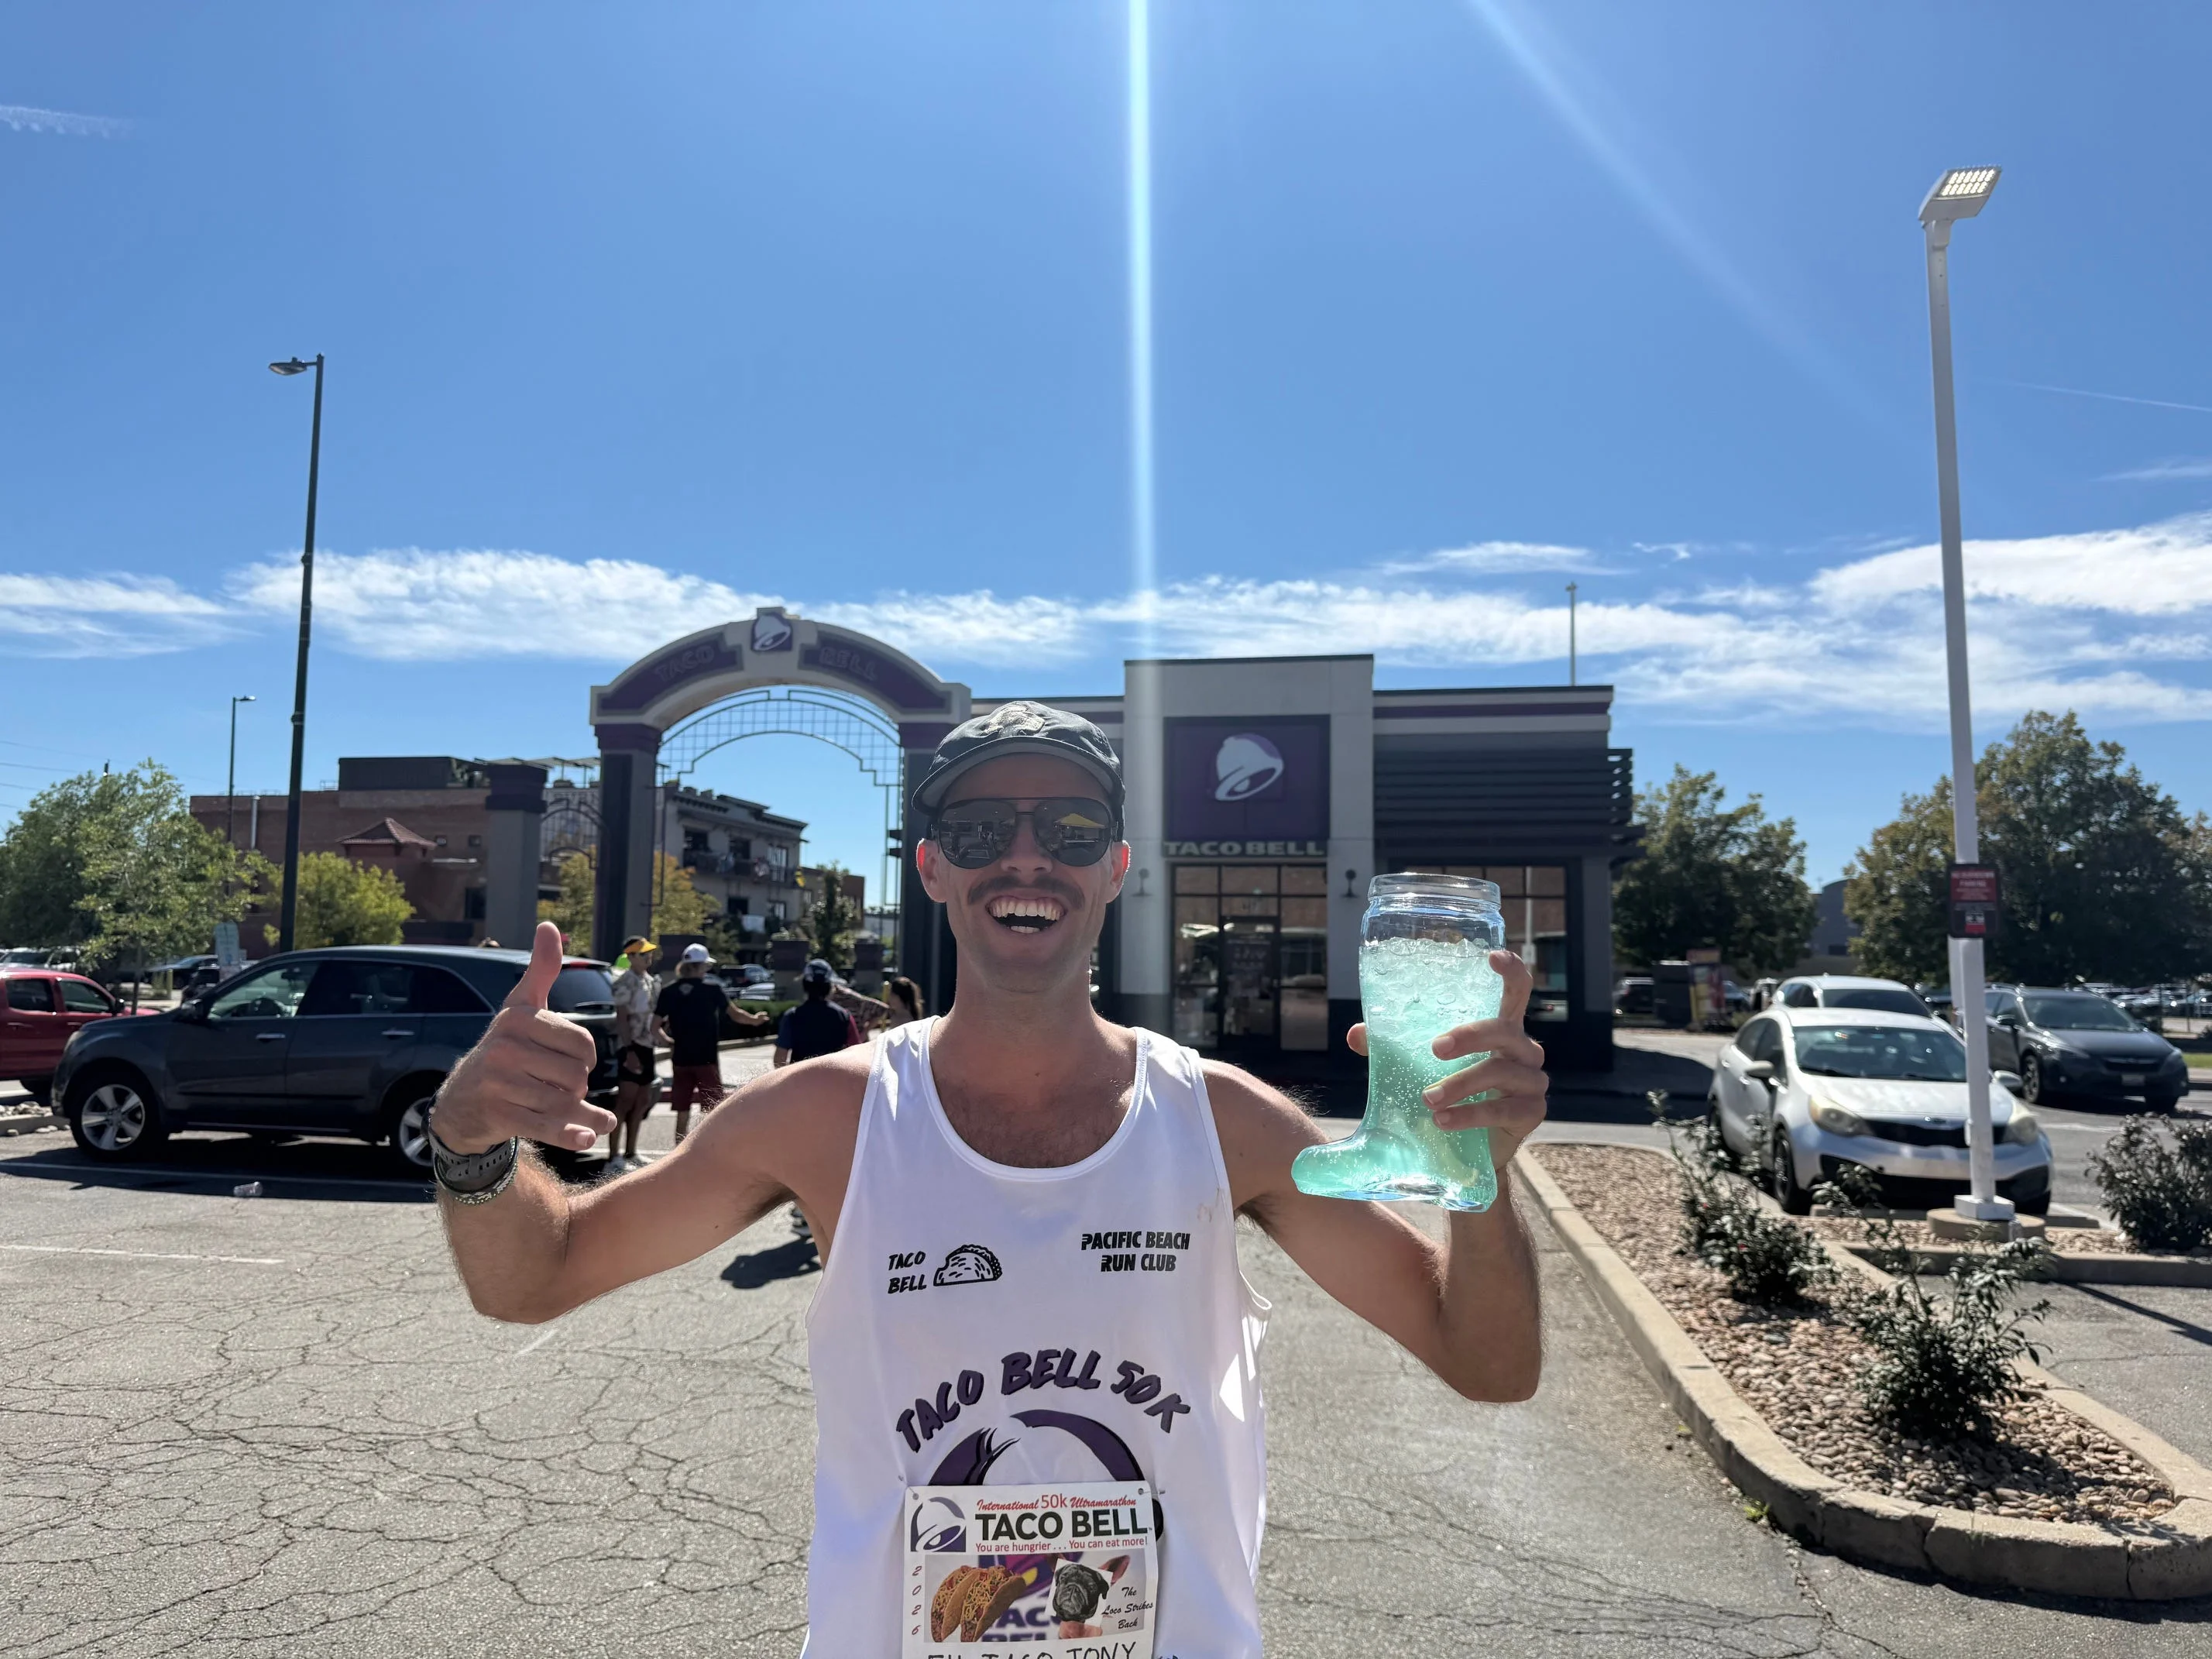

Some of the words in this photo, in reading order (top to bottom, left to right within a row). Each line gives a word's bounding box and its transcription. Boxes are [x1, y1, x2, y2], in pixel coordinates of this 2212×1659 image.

[654, 645, 715, 682] TACO
[819, 646, 878, 682] BELL
[1164, 841, 1242, 856] TACO
[1245, 841, 1324, 856] BELL
[1081, 1231, 1142, 1250] PACIFIC
[1145, 1231, 1190, 1250] BEACH
[888, 1251, 926, 1270] TACO
[1101, 1254, 1135, 1273] RUN
[1141, 1253, 1176, 1272] CLUB
[888, 1273, 927, 1293] BELL
[896, 1369, 984, 1453] TACO
[1001, 1348, 1101, 1395] BELL
[1110, 1360, 1191, 1434] 50K
[977, 1499, 1039, 1511] International
[1041, 1493, 1068, 1509] 50k
[1070, 1495, 1136, 1508] Ultramarathon
[975, 1511, 1063, 1540] TACO
[1072, 1508, 1148, 1537] BELL
[976, 1543, 992, 1552] You
[1012, 1541, 1051, 1554] hungrier
[1069, 1540, 1086, 1550] You
[1122, 1536, 1148, 1546] more!
[1121, 1586, 1137, 1597] The
[1101, 1605, 1121, 1615] Loco
[1125, 1600, 1153, 1613] Strikes
[1118, 1617, 1138, 1629] Back
